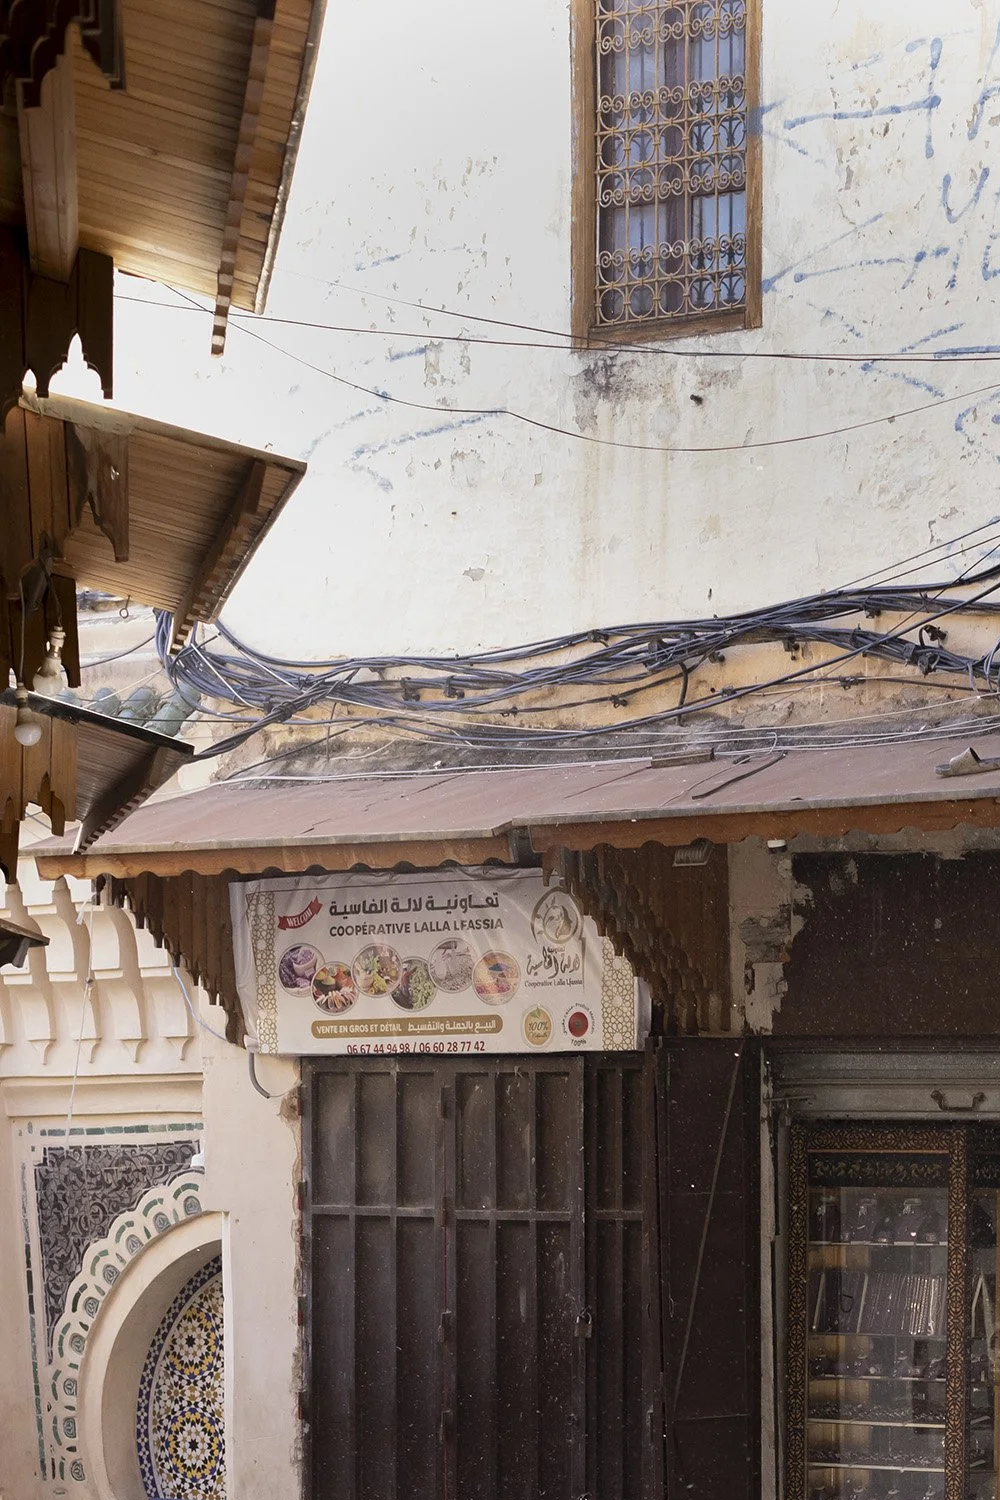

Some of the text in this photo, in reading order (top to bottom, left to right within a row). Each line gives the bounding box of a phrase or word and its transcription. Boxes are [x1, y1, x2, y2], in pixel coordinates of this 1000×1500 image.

[329, 898, 388, 919] الفاسية
[390, 897, 423, 913] لالة
[329, 917, 504, 937] COOPÉRATIVE LALLA LFASSIA
[316, 1022, 402, 1034] VENTE EN GROS ET DÉTAIL
[528, 1021, 549, 1032] 100%
[347, 1044, 358, 1054] 06
[360, 1044, 371, 1054] 67
[373, 1043, 384, 1053] 44
[386, 1043, 397, 1053] 94
[399, 1043, 410, 1053] 98
[419, 1042, 431, 1053] 06
[433, 1042, 444, 1052] 60
[447, 1041, 458, 1052] 28
[460, 1041, 471, 1051] 77
[474, 1041, 485, 1051] 42
